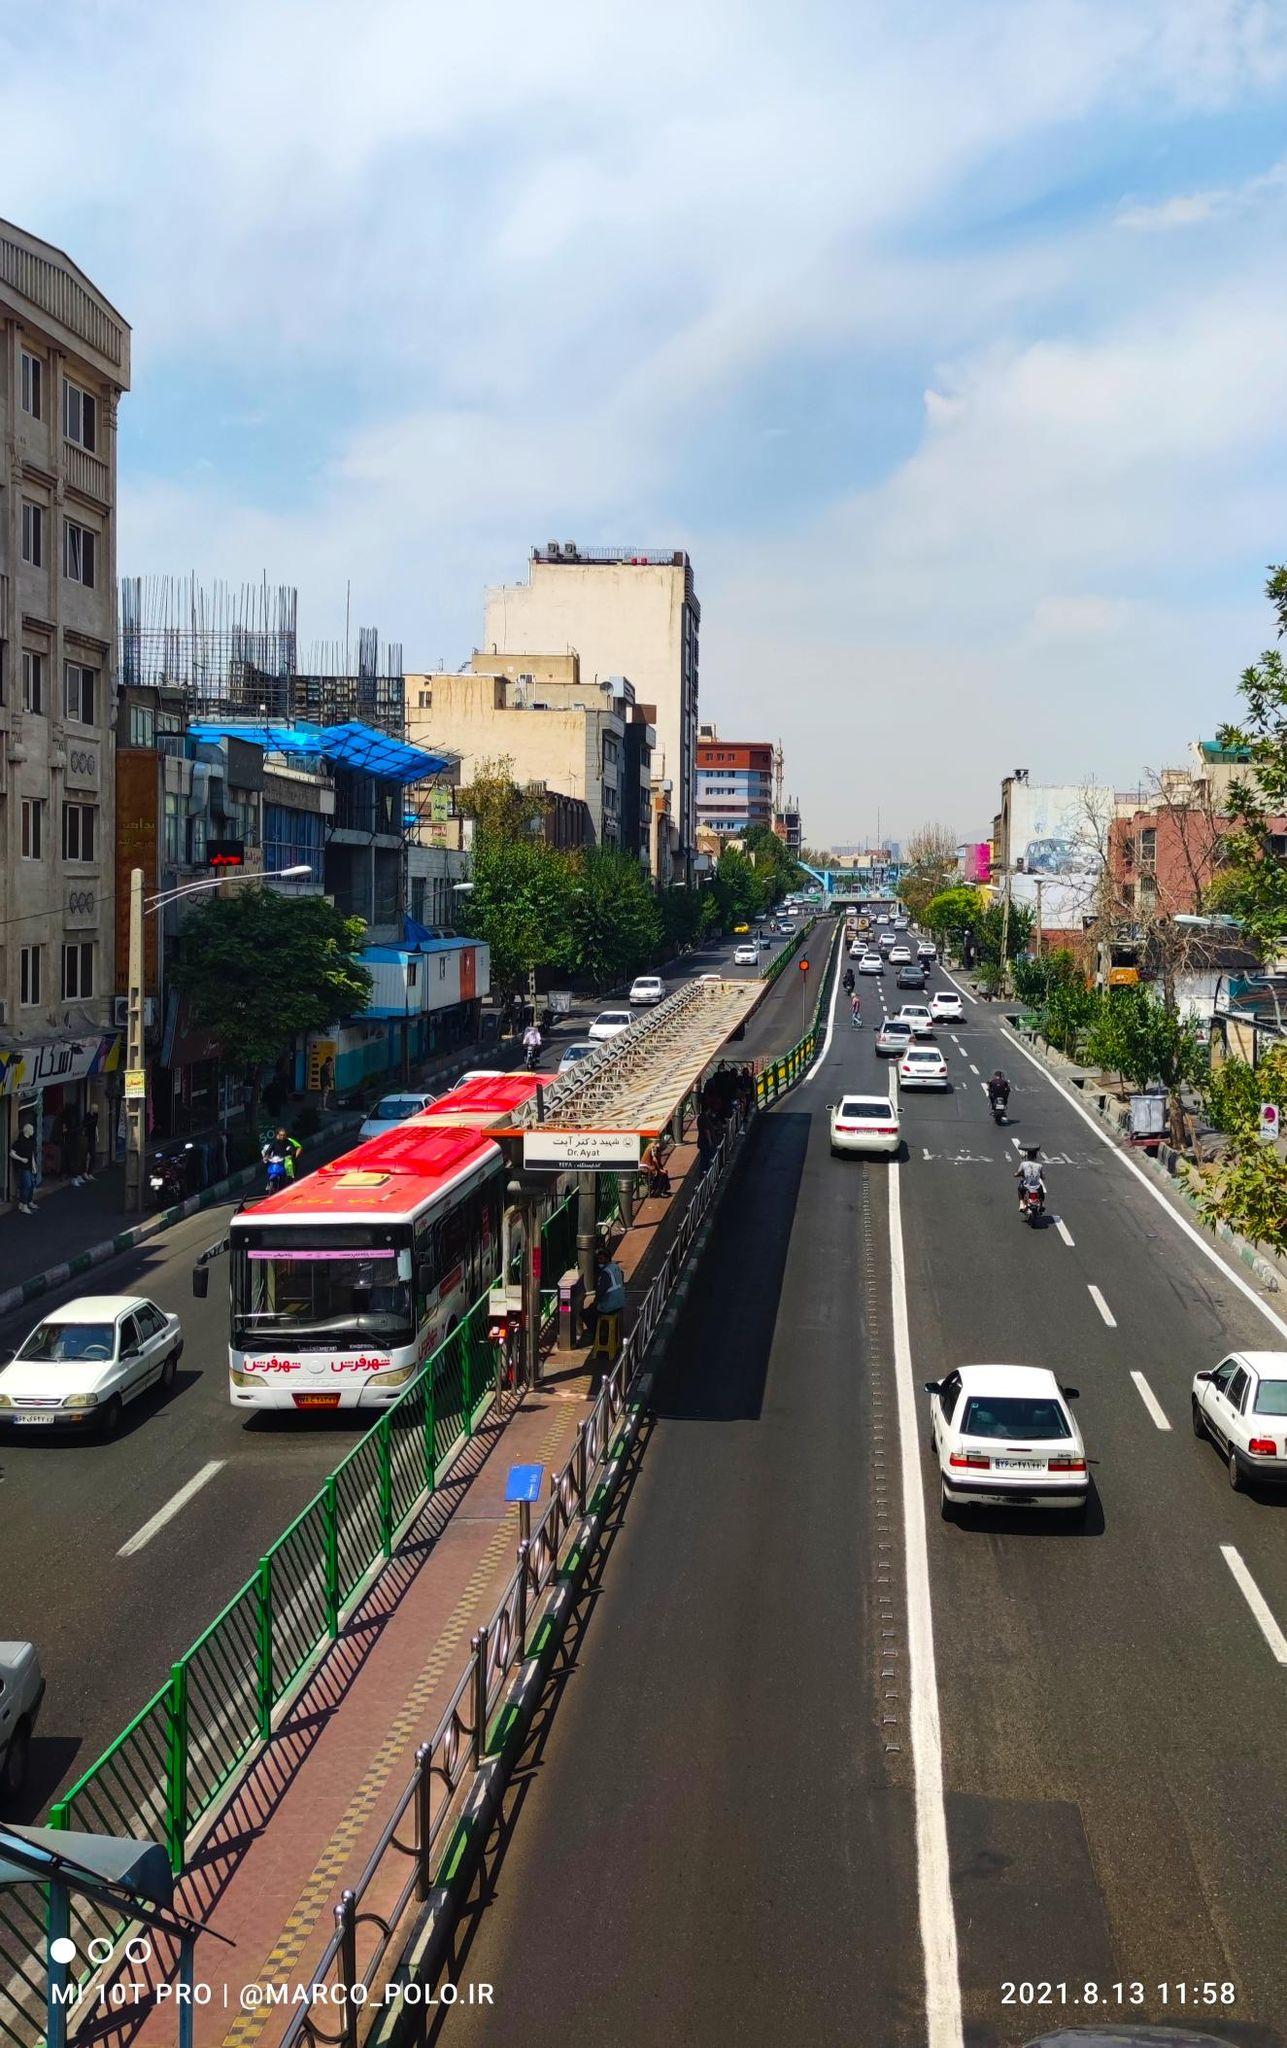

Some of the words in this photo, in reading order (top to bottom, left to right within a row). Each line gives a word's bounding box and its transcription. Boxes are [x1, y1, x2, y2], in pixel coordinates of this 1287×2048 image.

[552, 1135, 572, 1147] آیت
[575, 1136, 597, 1148] دکتر
[598, 1137, 620, 1148] شهید
[580, 1148, 600, 1159] Ayat
[243, 1355, 301, 1373] شهرفرش
[330, 1354, 391, 1373] شهرفرش
